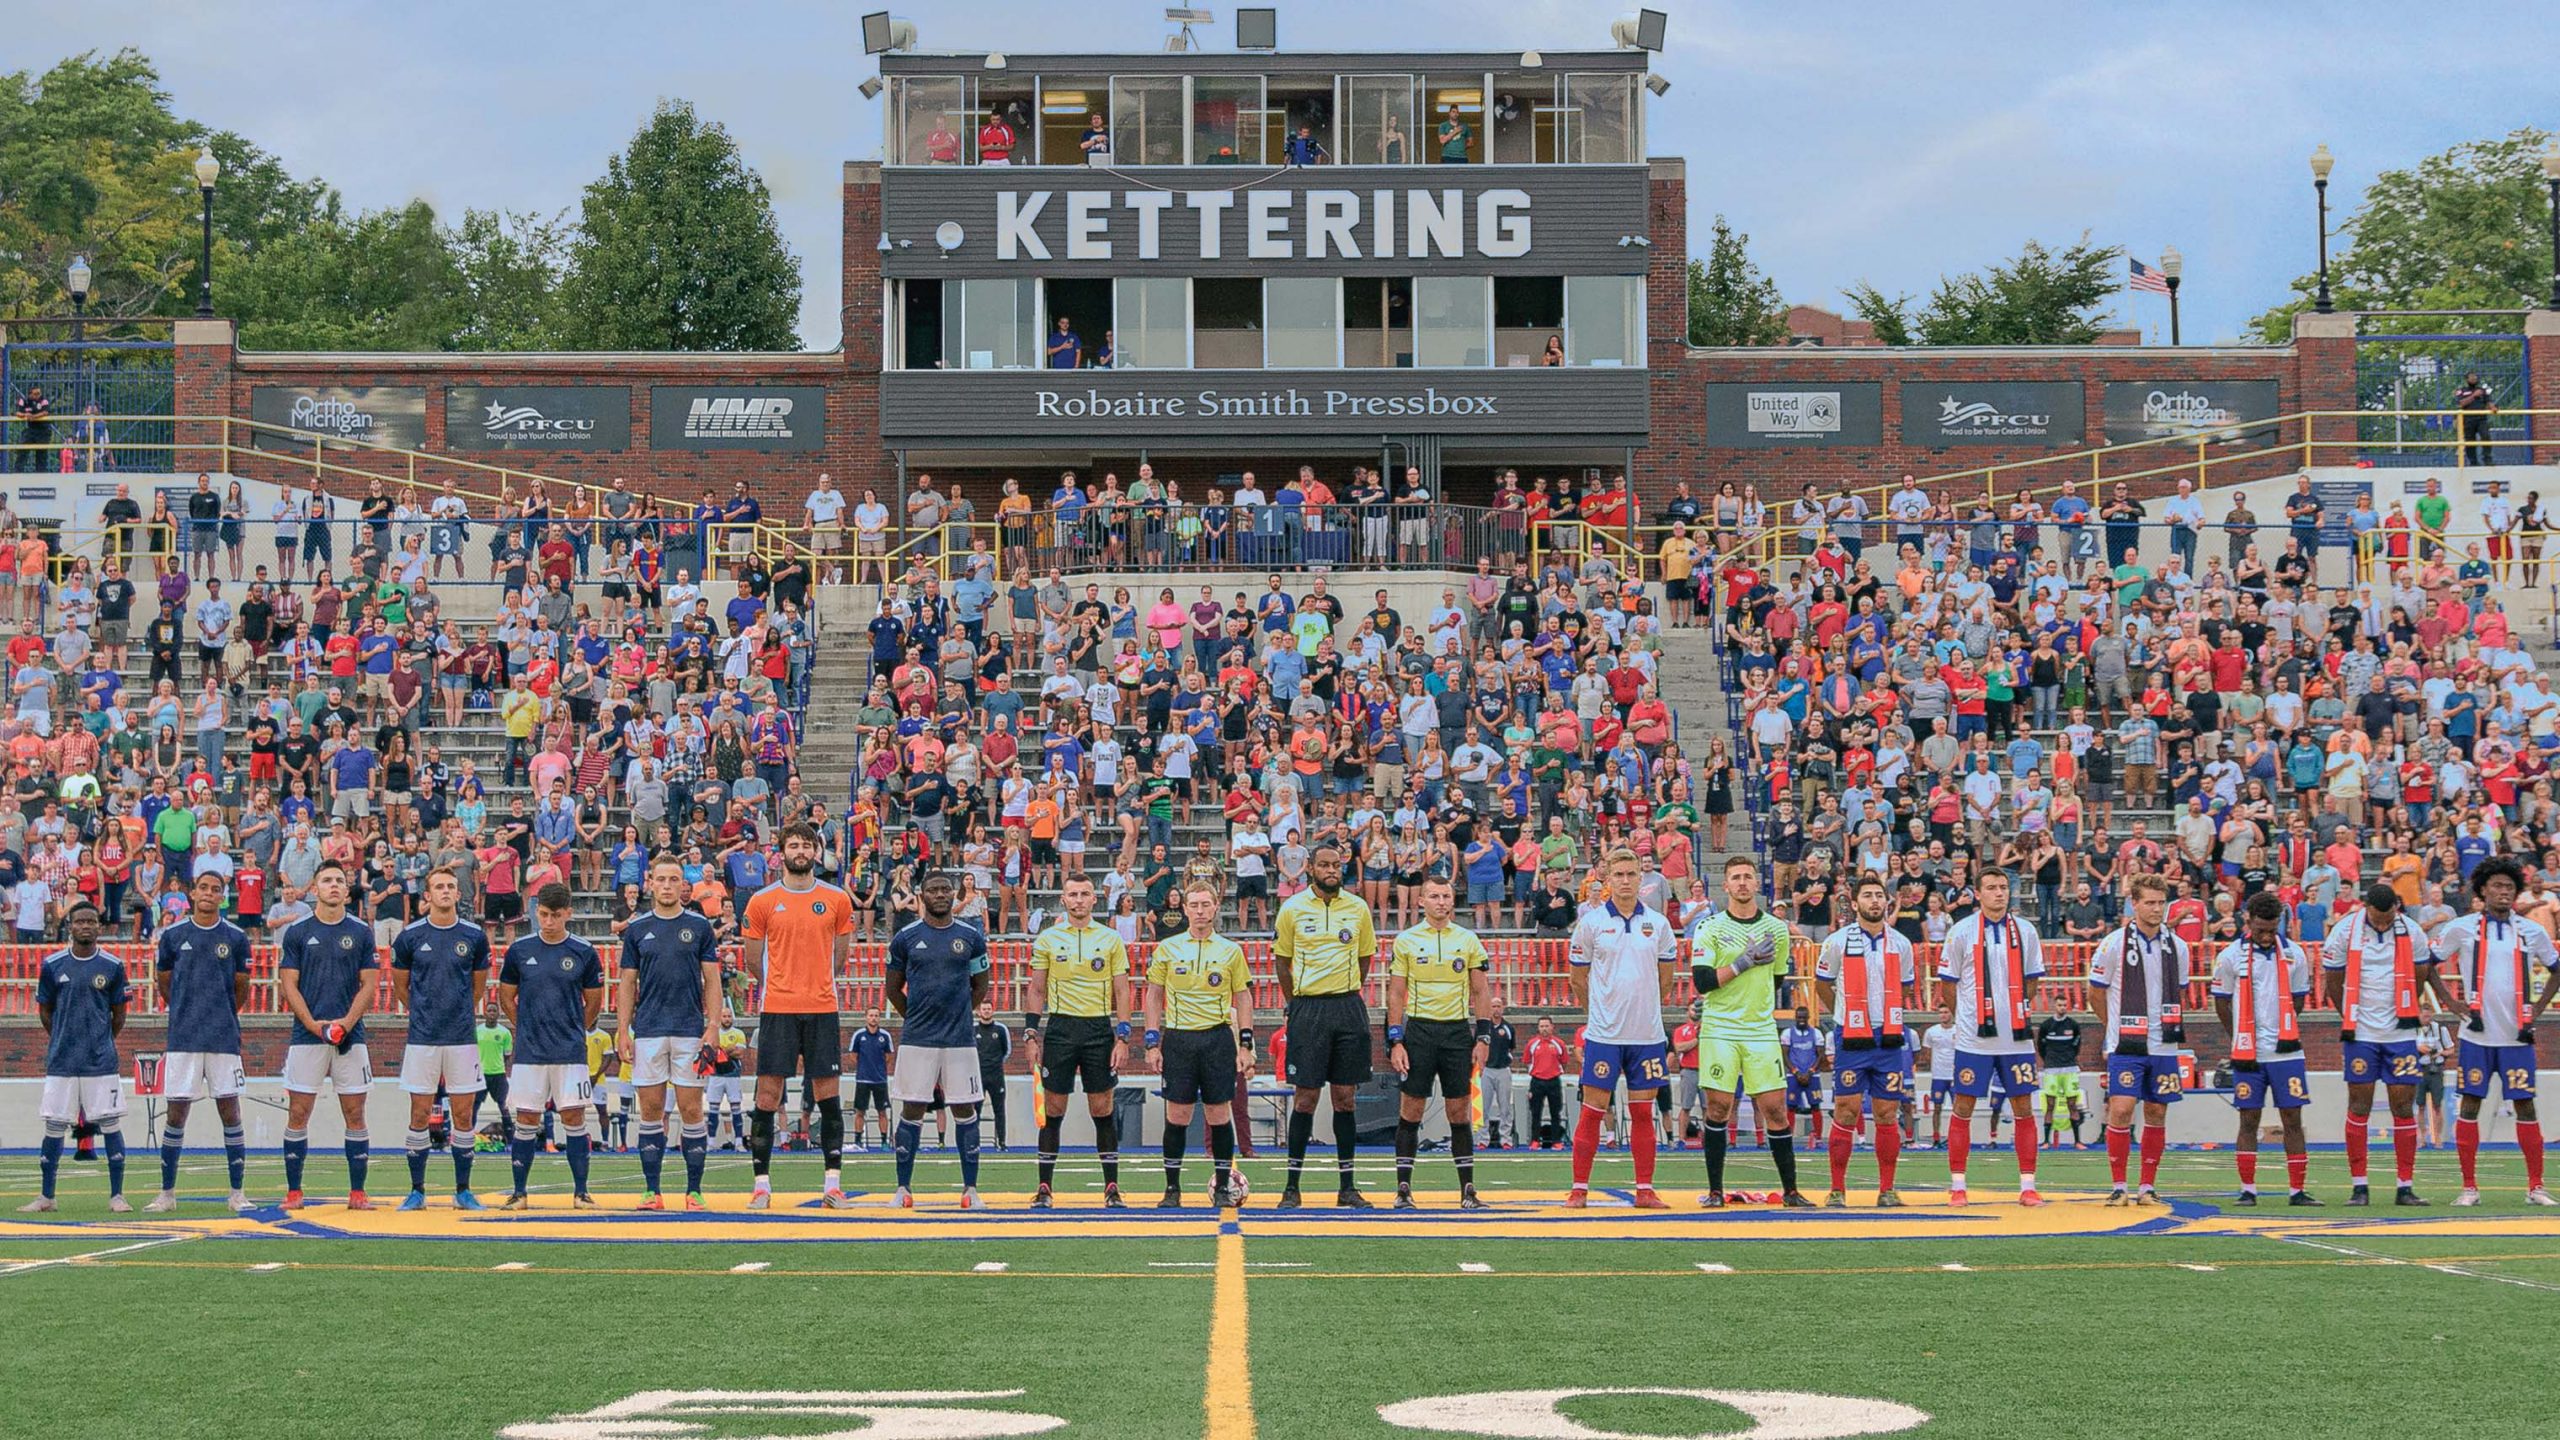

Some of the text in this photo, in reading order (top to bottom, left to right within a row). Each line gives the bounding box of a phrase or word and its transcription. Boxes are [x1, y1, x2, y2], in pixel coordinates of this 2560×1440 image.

[996, 188, 1532, 260] KETTERING
[295, 396, 356, 415] Ortho
[1035, 388, 1498, 417] Robaire Smith Pressbox
[1751, 398, 1800, 411] United
[2146, 390, 2210, 410] Ortho
[684, 398, 794, 430] MMR
[1770, 412, 1800, 429] Way
[1972, 414, 2051, 426] PFCU
[518, 419, 597, 431] PFCU
[1941, 427, 2047, 436] Proud to be Your Credit Union
[486, 431, 591, 440] Proud to be Your Credit Union
[1262, 509, 1274, 533] 1
[438, 528, 452, 552] 3
[2079, 531, 2094, 554] 2
[102, 846, 123, 860] LOVE
[1641, 1058, 1664, 1081] 15
[1774, 1058, 1784, 1079] 1
[2010, 1062, 2035, 1085] 13
[2392, 1054, 2418, 1077] 22
[233, 1068, 246, 1088] 13
[2288, 1076, 2303, 1098] 8
[2505, 1068, 2529, 1090] 12
[110, 1089, 119, 1108] 7
[577, 1080, 591, 1100] 10
